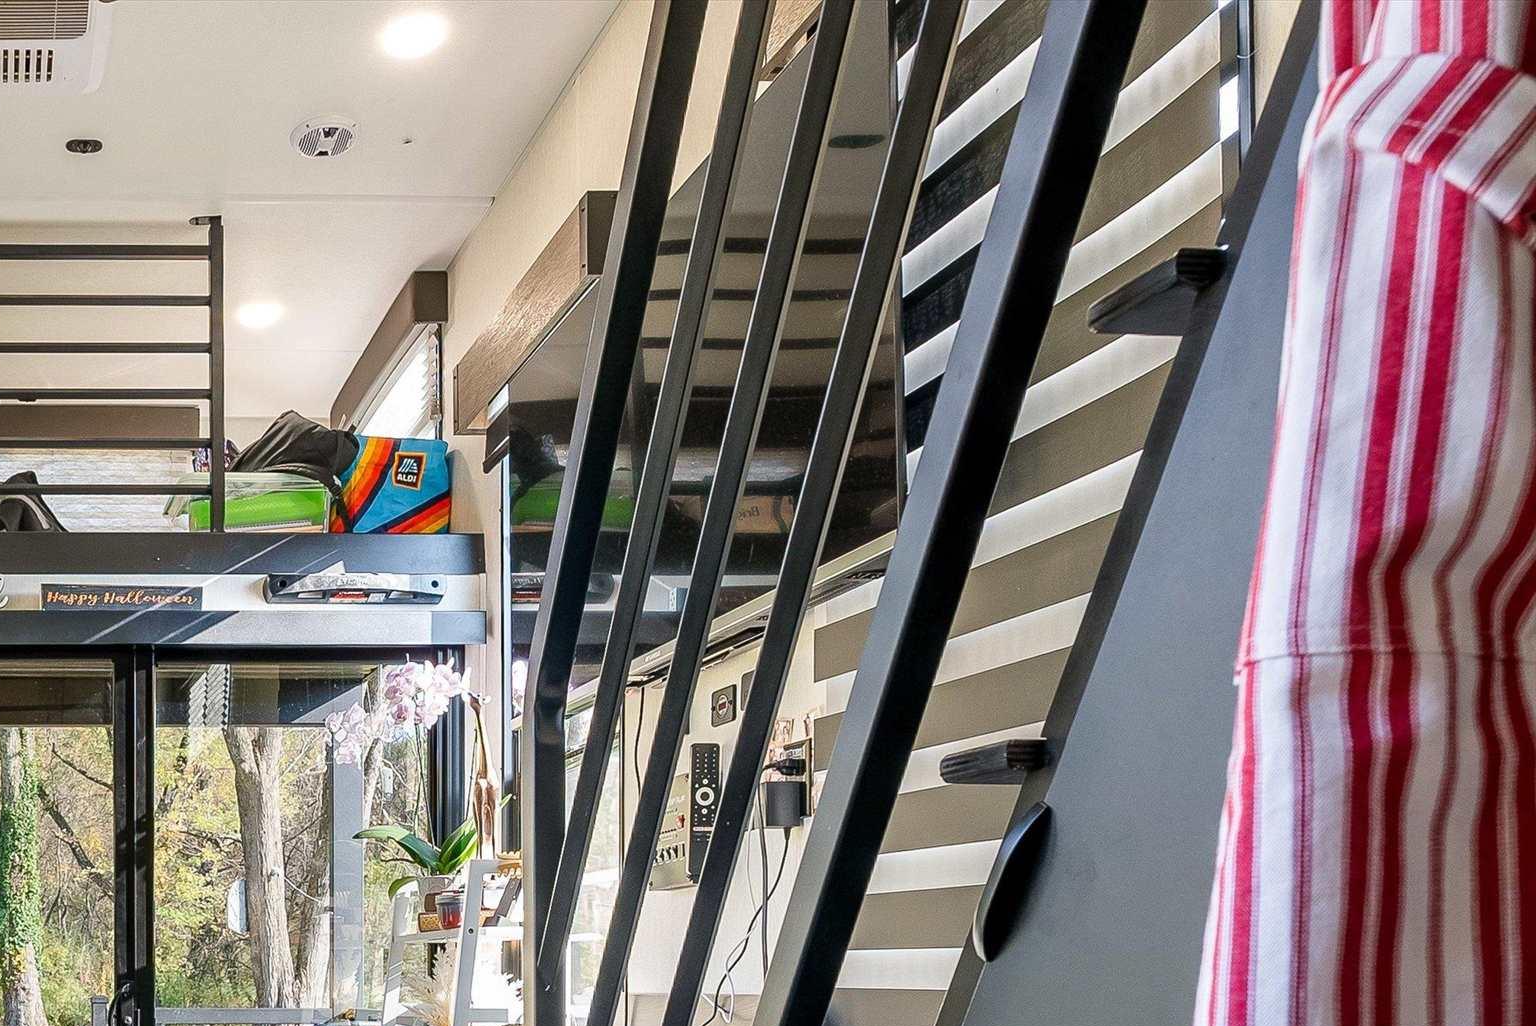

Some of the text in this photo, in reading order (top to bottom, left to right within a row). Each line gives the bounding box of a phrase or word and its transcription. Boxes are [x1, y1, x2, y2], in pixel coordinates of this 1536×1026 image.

[397, 473, 417, 483] ALDI
[46, 590, 197, 605] Happy Halloween
